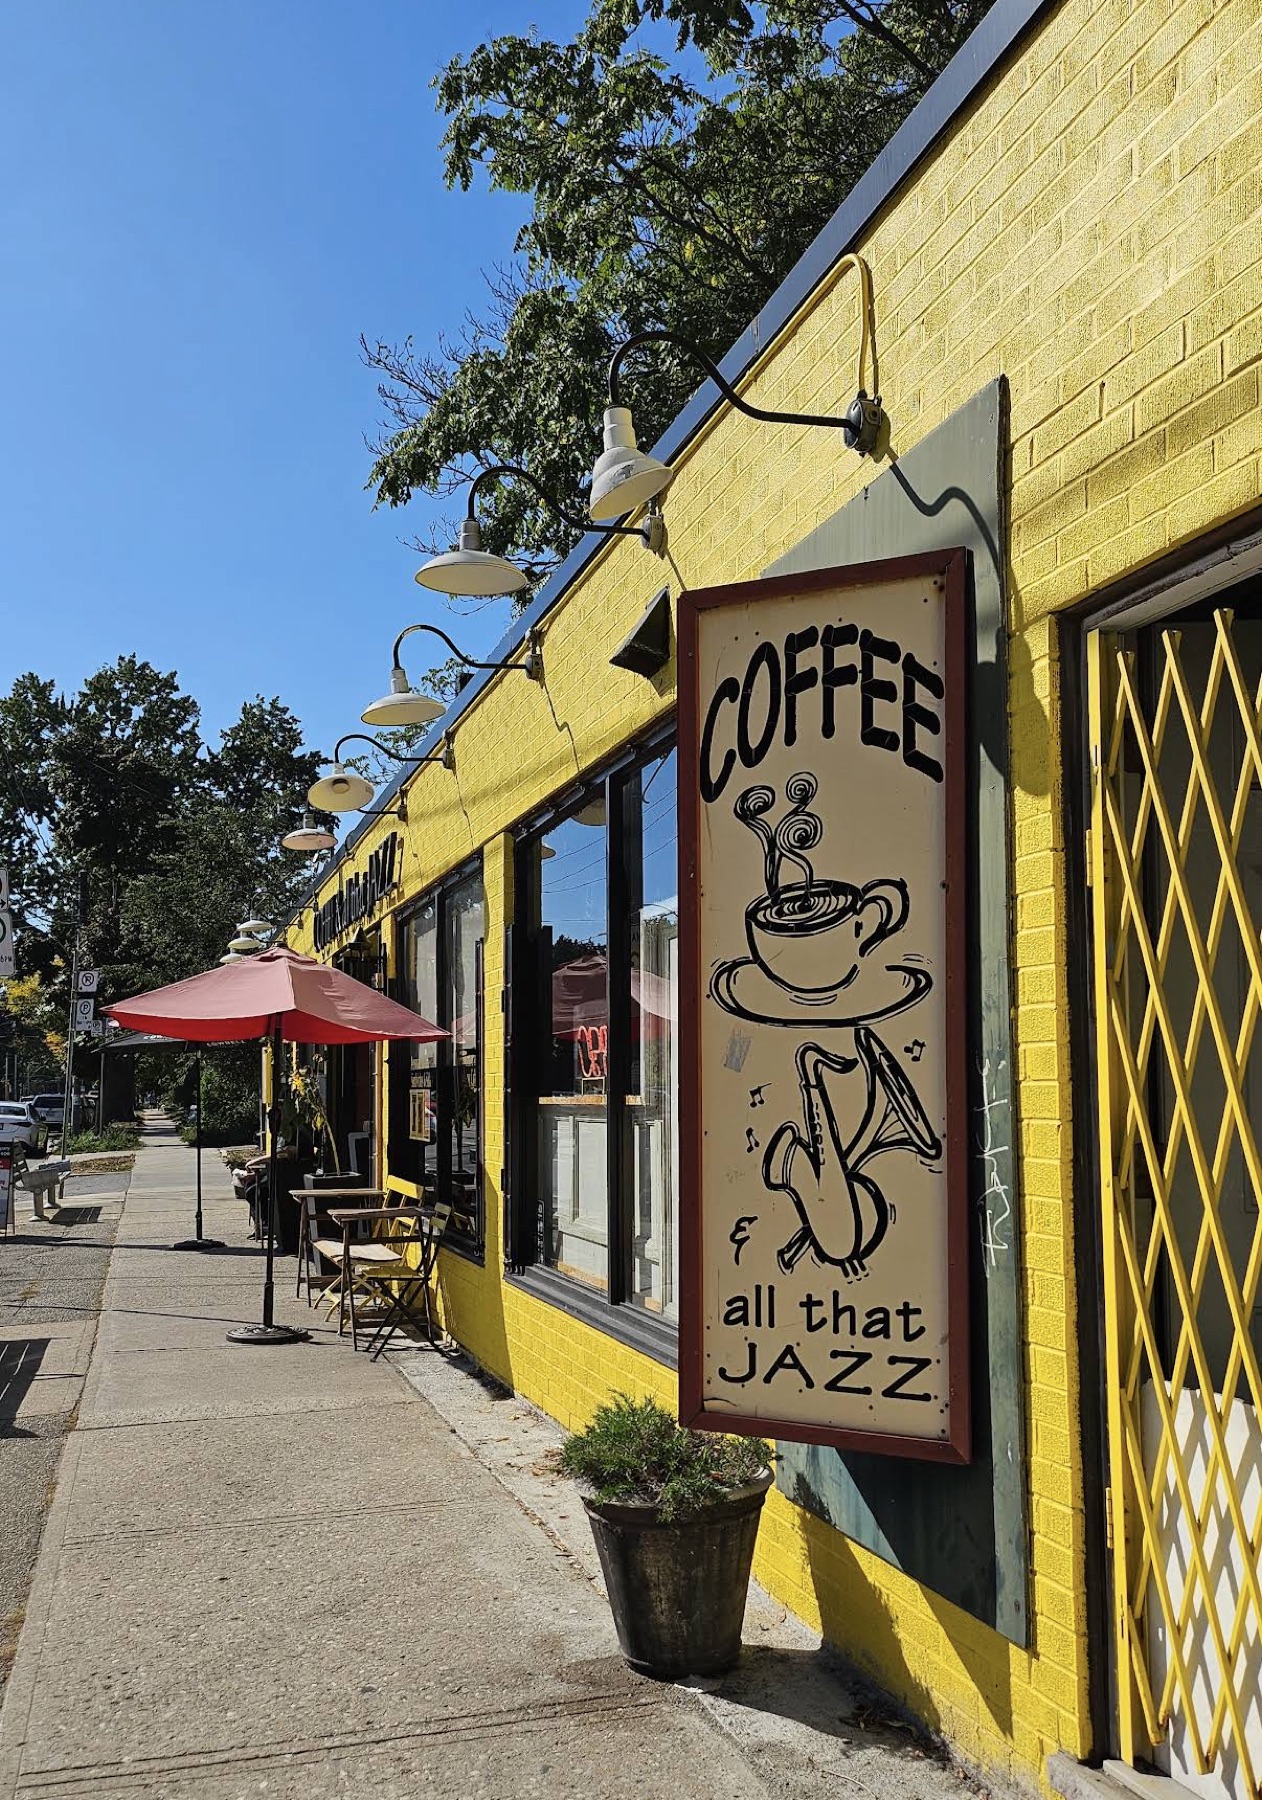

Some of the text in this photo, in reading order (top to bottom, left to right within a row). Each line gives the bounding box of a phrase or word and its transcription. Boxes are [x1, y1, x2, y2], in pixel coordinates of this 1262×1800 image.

[700, 623, 945, 803] COFFEE
[723, 1284, 926, 1342] all that
[718, 1342, 932, 1402] JAZZ
